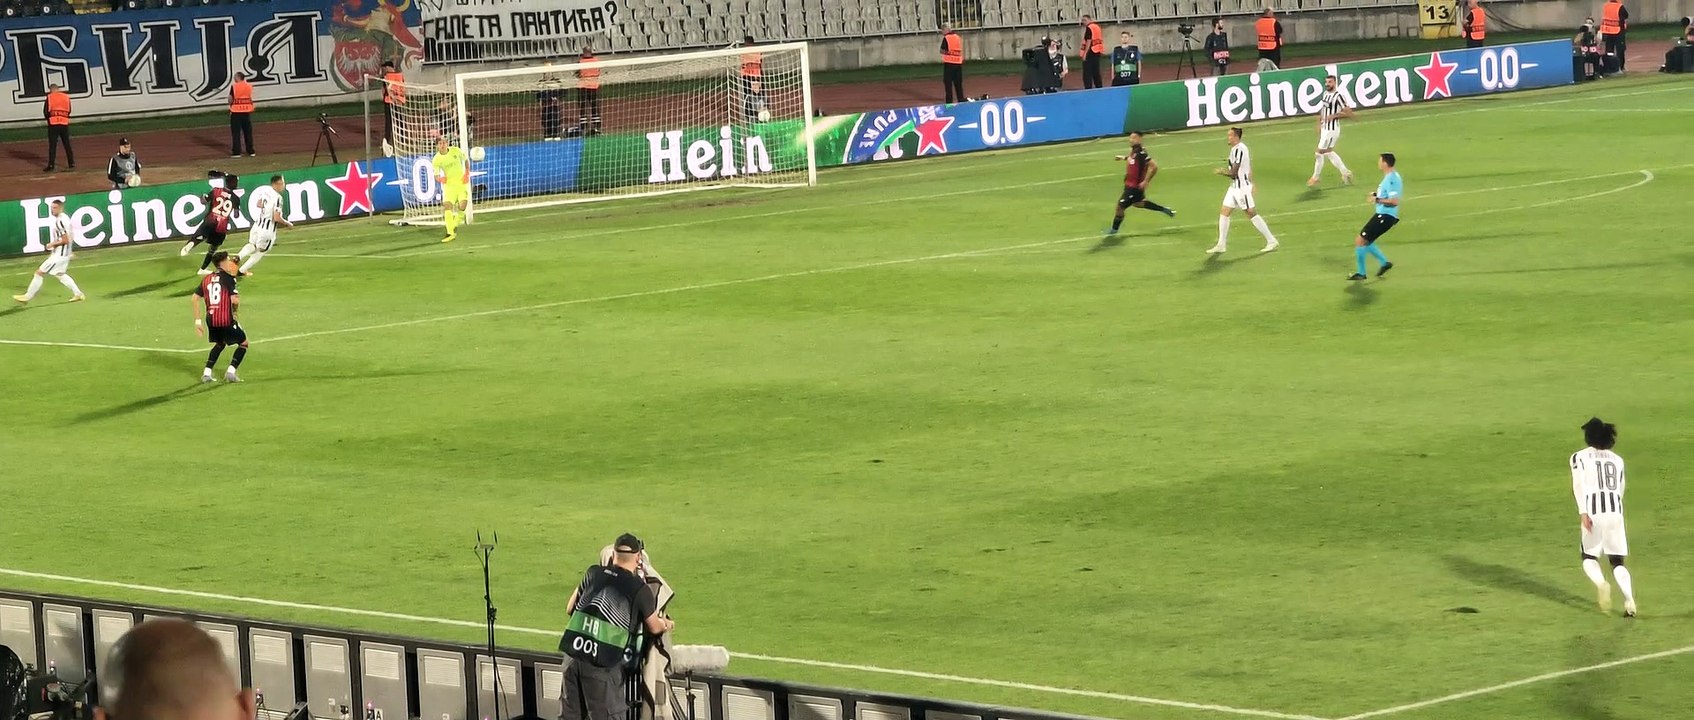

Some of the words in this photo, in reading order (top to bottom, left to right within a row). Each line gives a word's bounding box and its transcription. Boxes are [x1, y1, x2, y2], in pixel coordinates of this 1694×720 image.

[1426, 5, 1450, 20] 13
[1184, 64, 1414, 127] Heineken
[859, 109, 898, 149] PURE
[646, 126, 773, 183] Hein
[212, 196, 233, 218] 29
[206, 282, 222, 306] 18
[1595, 460, 1618, 491] 18
[573, 636, 599, 658] 003
